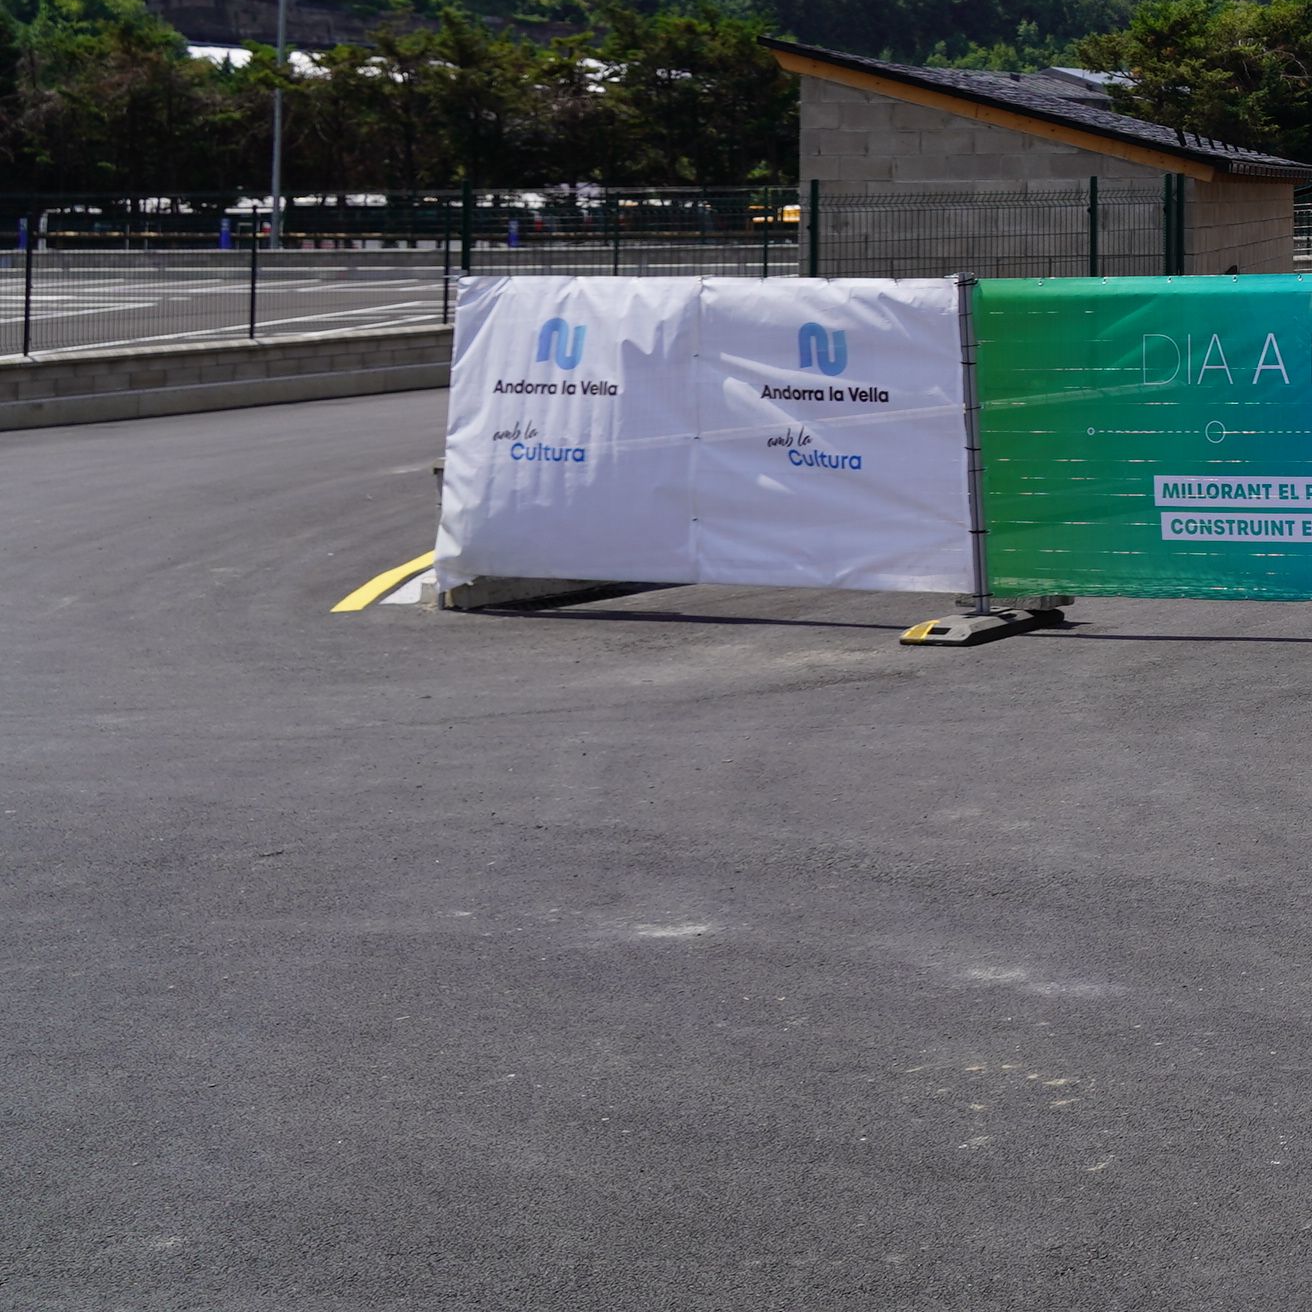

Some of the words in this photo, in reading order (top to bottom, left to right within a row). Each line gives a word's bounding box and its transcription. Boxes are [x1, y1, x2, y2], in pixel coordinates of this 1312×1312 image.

[1142, 333, 1233, 385] DIA
[1252, 332, 1290, 385] A
[493, 380, 557, 395] Andorra
[562, 380, 576, 395] la
[580, 381, 618, 396] Vella
[761, 385, 824, 402] Andorra
[829, 387, 844, 402] la
[848, 388, 889, 403] Vella
[493, 421, 521, 442] amb
[524, 419, 537, 440] la
[767, 428, 794, 448] amb
[797, 426, 812, 447] la
[510, 444, 586, 462] Cultura
[787, 449, 862, 470] Cultura
[1162, 483, 1272, 500] MILLORANT
[1278, 483, 1300, 500] EL
[1170, 518, 1294, 536] CONSTRUINT
